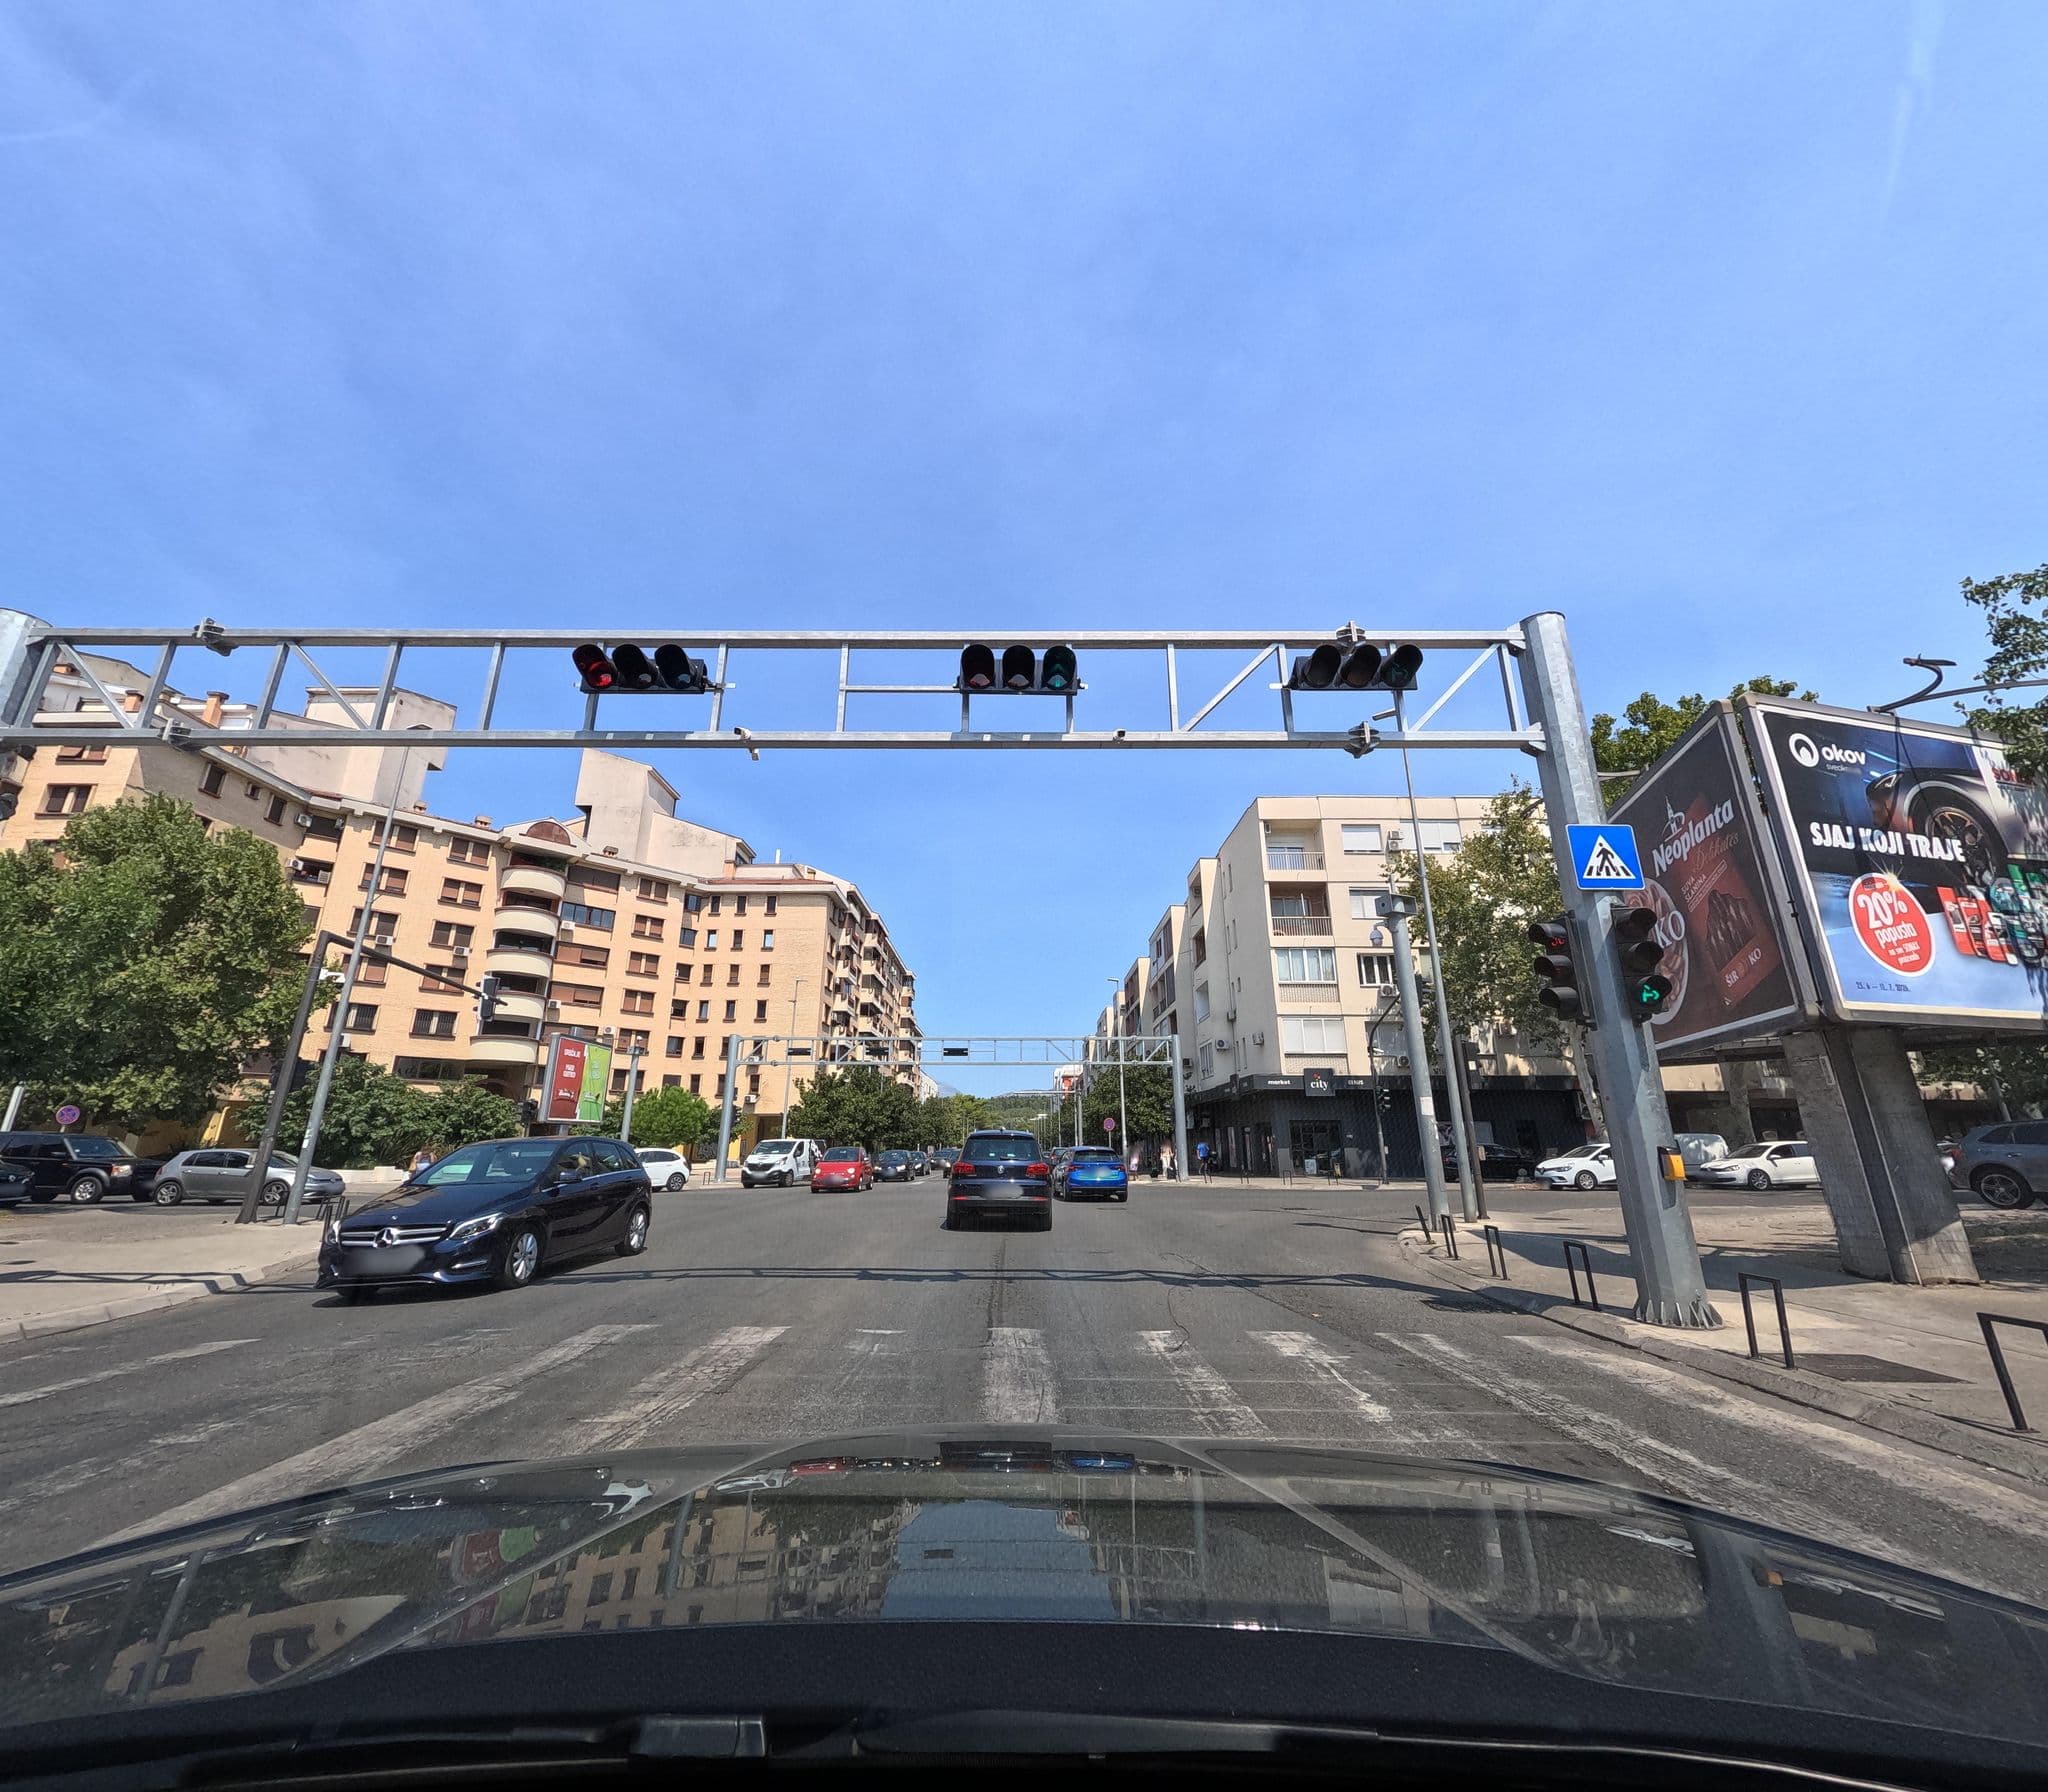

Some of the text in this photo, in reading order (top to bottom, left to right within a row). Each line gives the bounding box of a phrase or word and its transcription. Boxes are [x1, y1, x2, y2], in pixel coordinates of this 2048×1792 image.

[1821, 744, 1866, 765] okov
[1652, 798, 1735, 877] Neoplanta
[1810, 822, 1966, 862] SJAJ KOJI TRAJE
[1857, 890, 1908, 929] 20%
[1874, 920, 1918, 949] popusta
[1310, 1079, 1328, 1091] city
